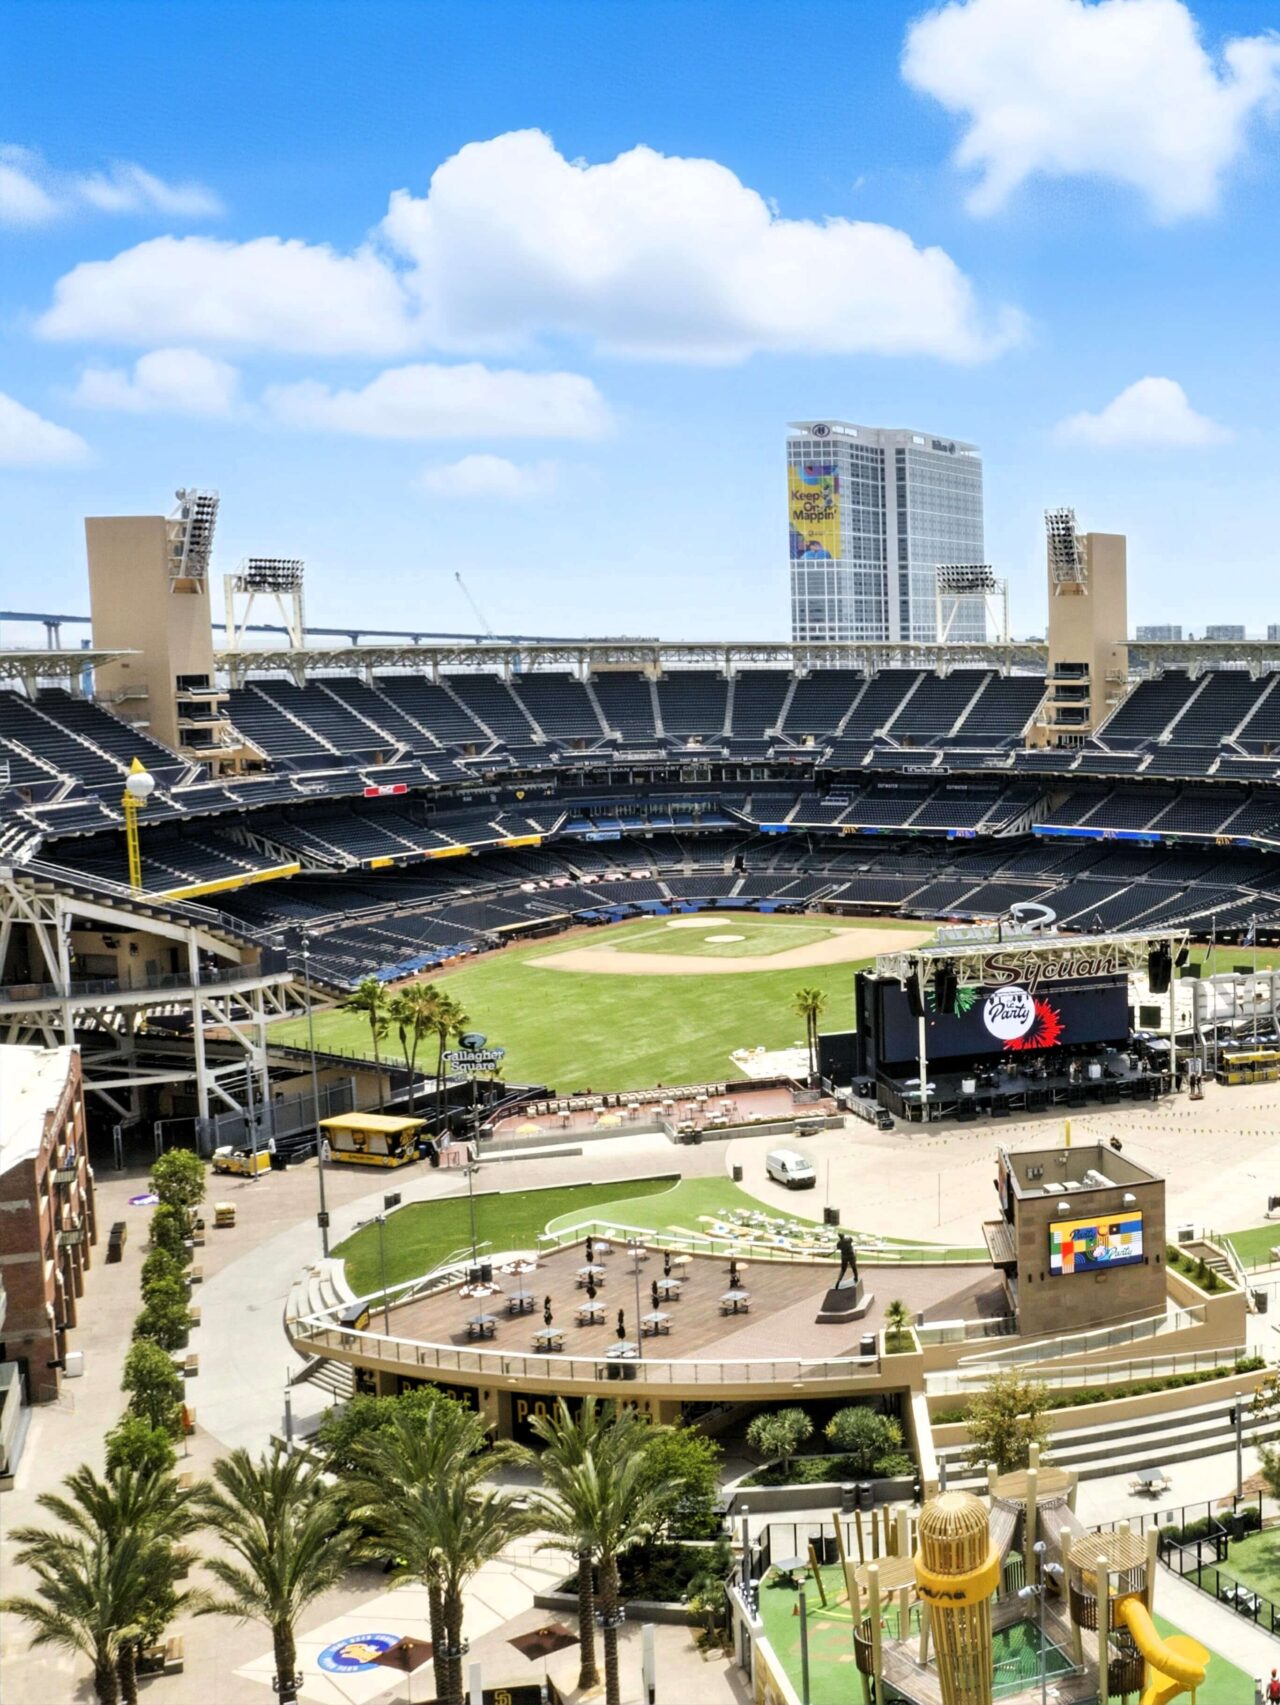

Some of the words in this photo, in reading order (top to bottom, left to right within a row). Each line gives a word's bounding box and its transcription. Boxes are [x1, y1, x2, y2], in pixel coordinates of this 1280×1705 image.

[983, 950, 1119, 994] Sycuan
[988, 1001, 1030, 1024] Party
[441, 1050, 503, 1062] Gallagher
[452, 1061, 495, 1072] Square
